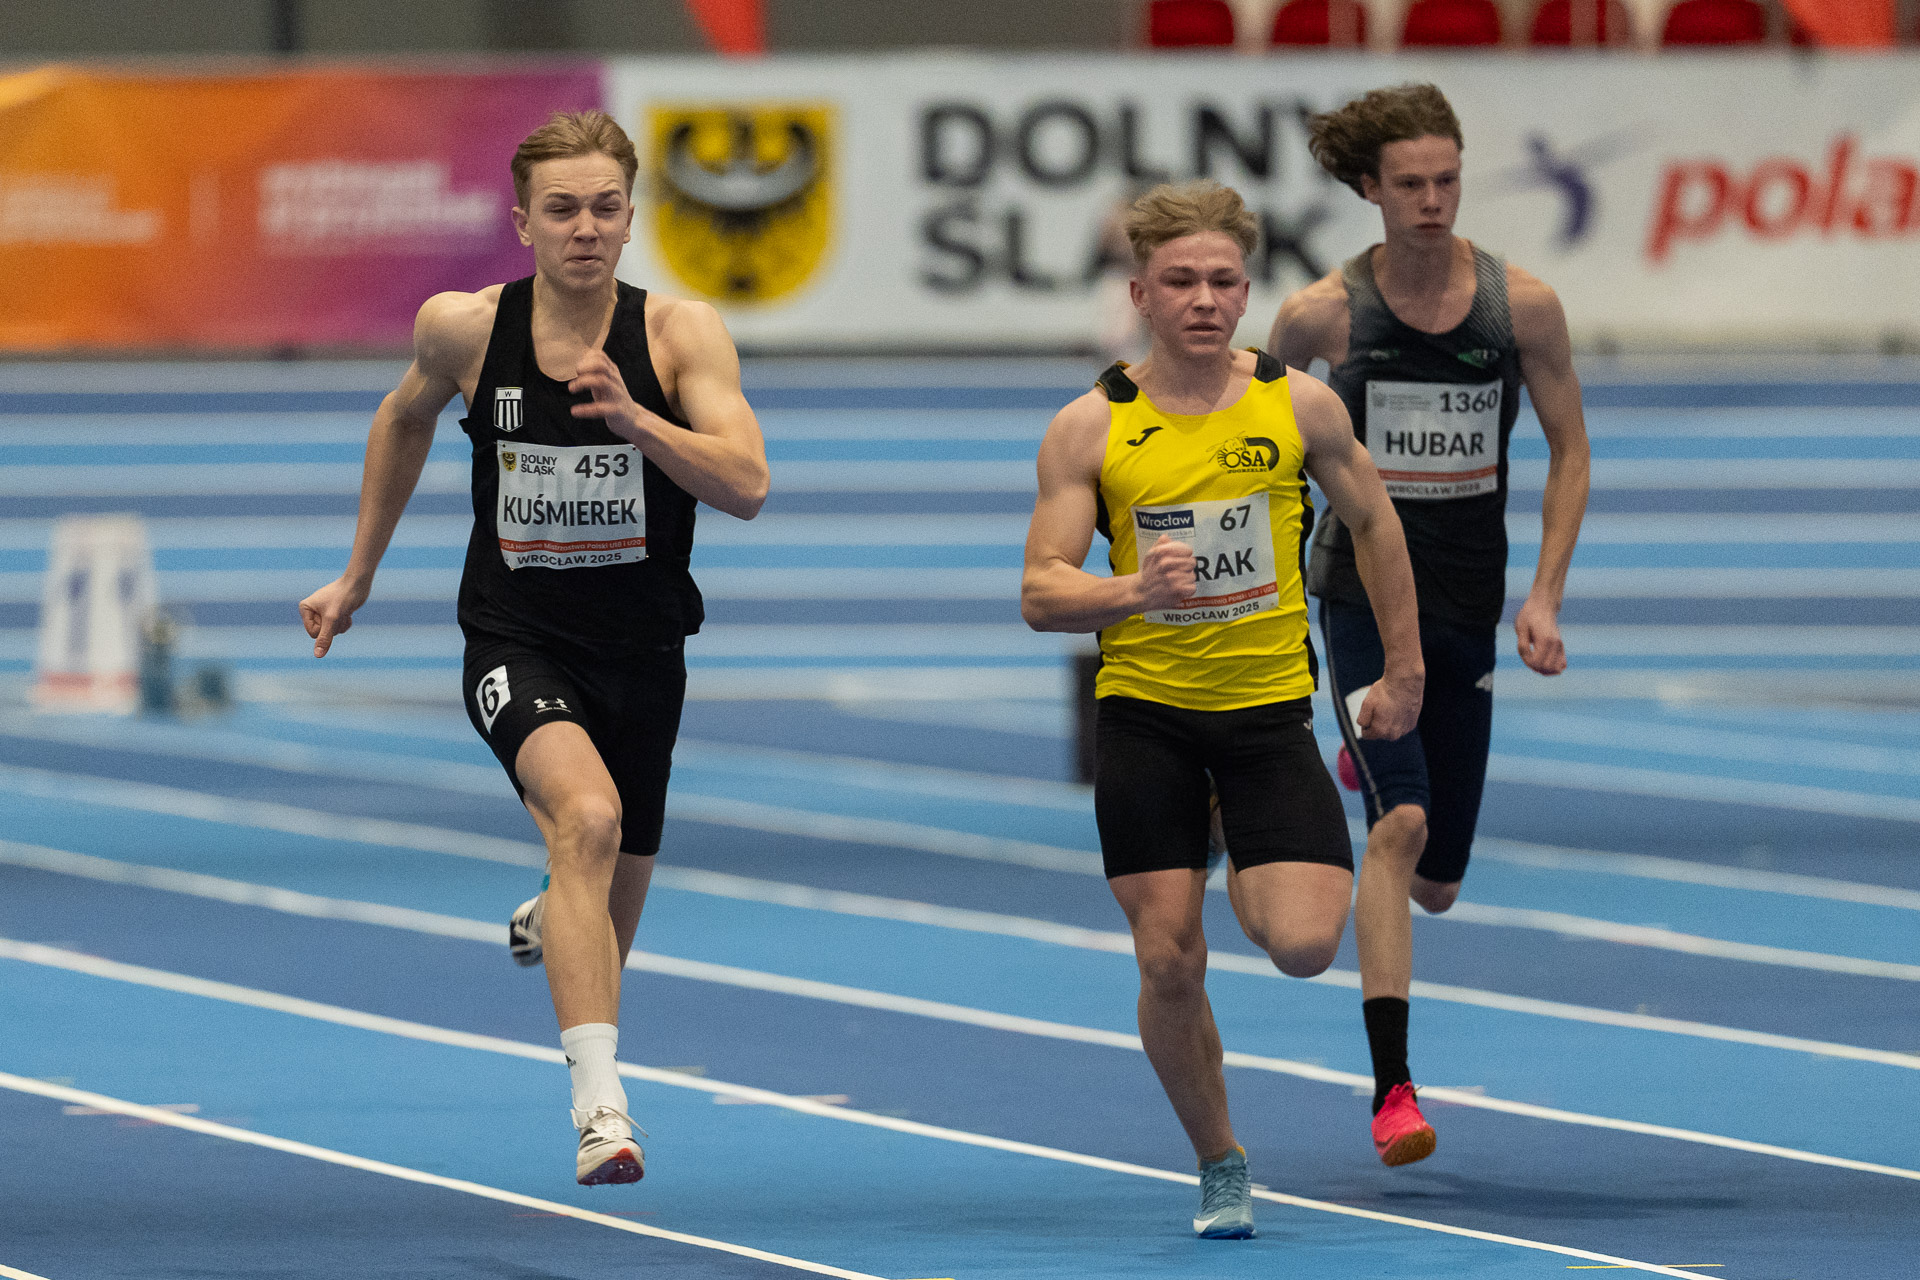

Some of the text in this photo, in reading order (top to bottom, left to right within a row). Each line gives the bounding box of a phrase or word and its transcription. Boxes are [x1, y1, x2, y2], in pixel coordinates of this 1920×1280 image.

[922, 197, 1330, 291] ŚLK
[504, 390, 513, 398] W
[1440, 388, 1498, 413] 1360
[1385, 431, 1484, 457] HUBAR
[521, 453, 629, 479] DOLNY 453
[521, 462, 555, 476] ŚLĄSK
[503, 494, 638, 527] KUŚMIEREK
[1139, 514, 1191, 528] Wrocław
[1219, 504, 1251, 532] 67
[517, 552, 622, 566] WROCŁAW 2025
[544, 543, 585, 551] Mistrzostwa
[1163, 601, 1260, 623] WROCŁAW 2025
[481, 677, 500, 718] 6
